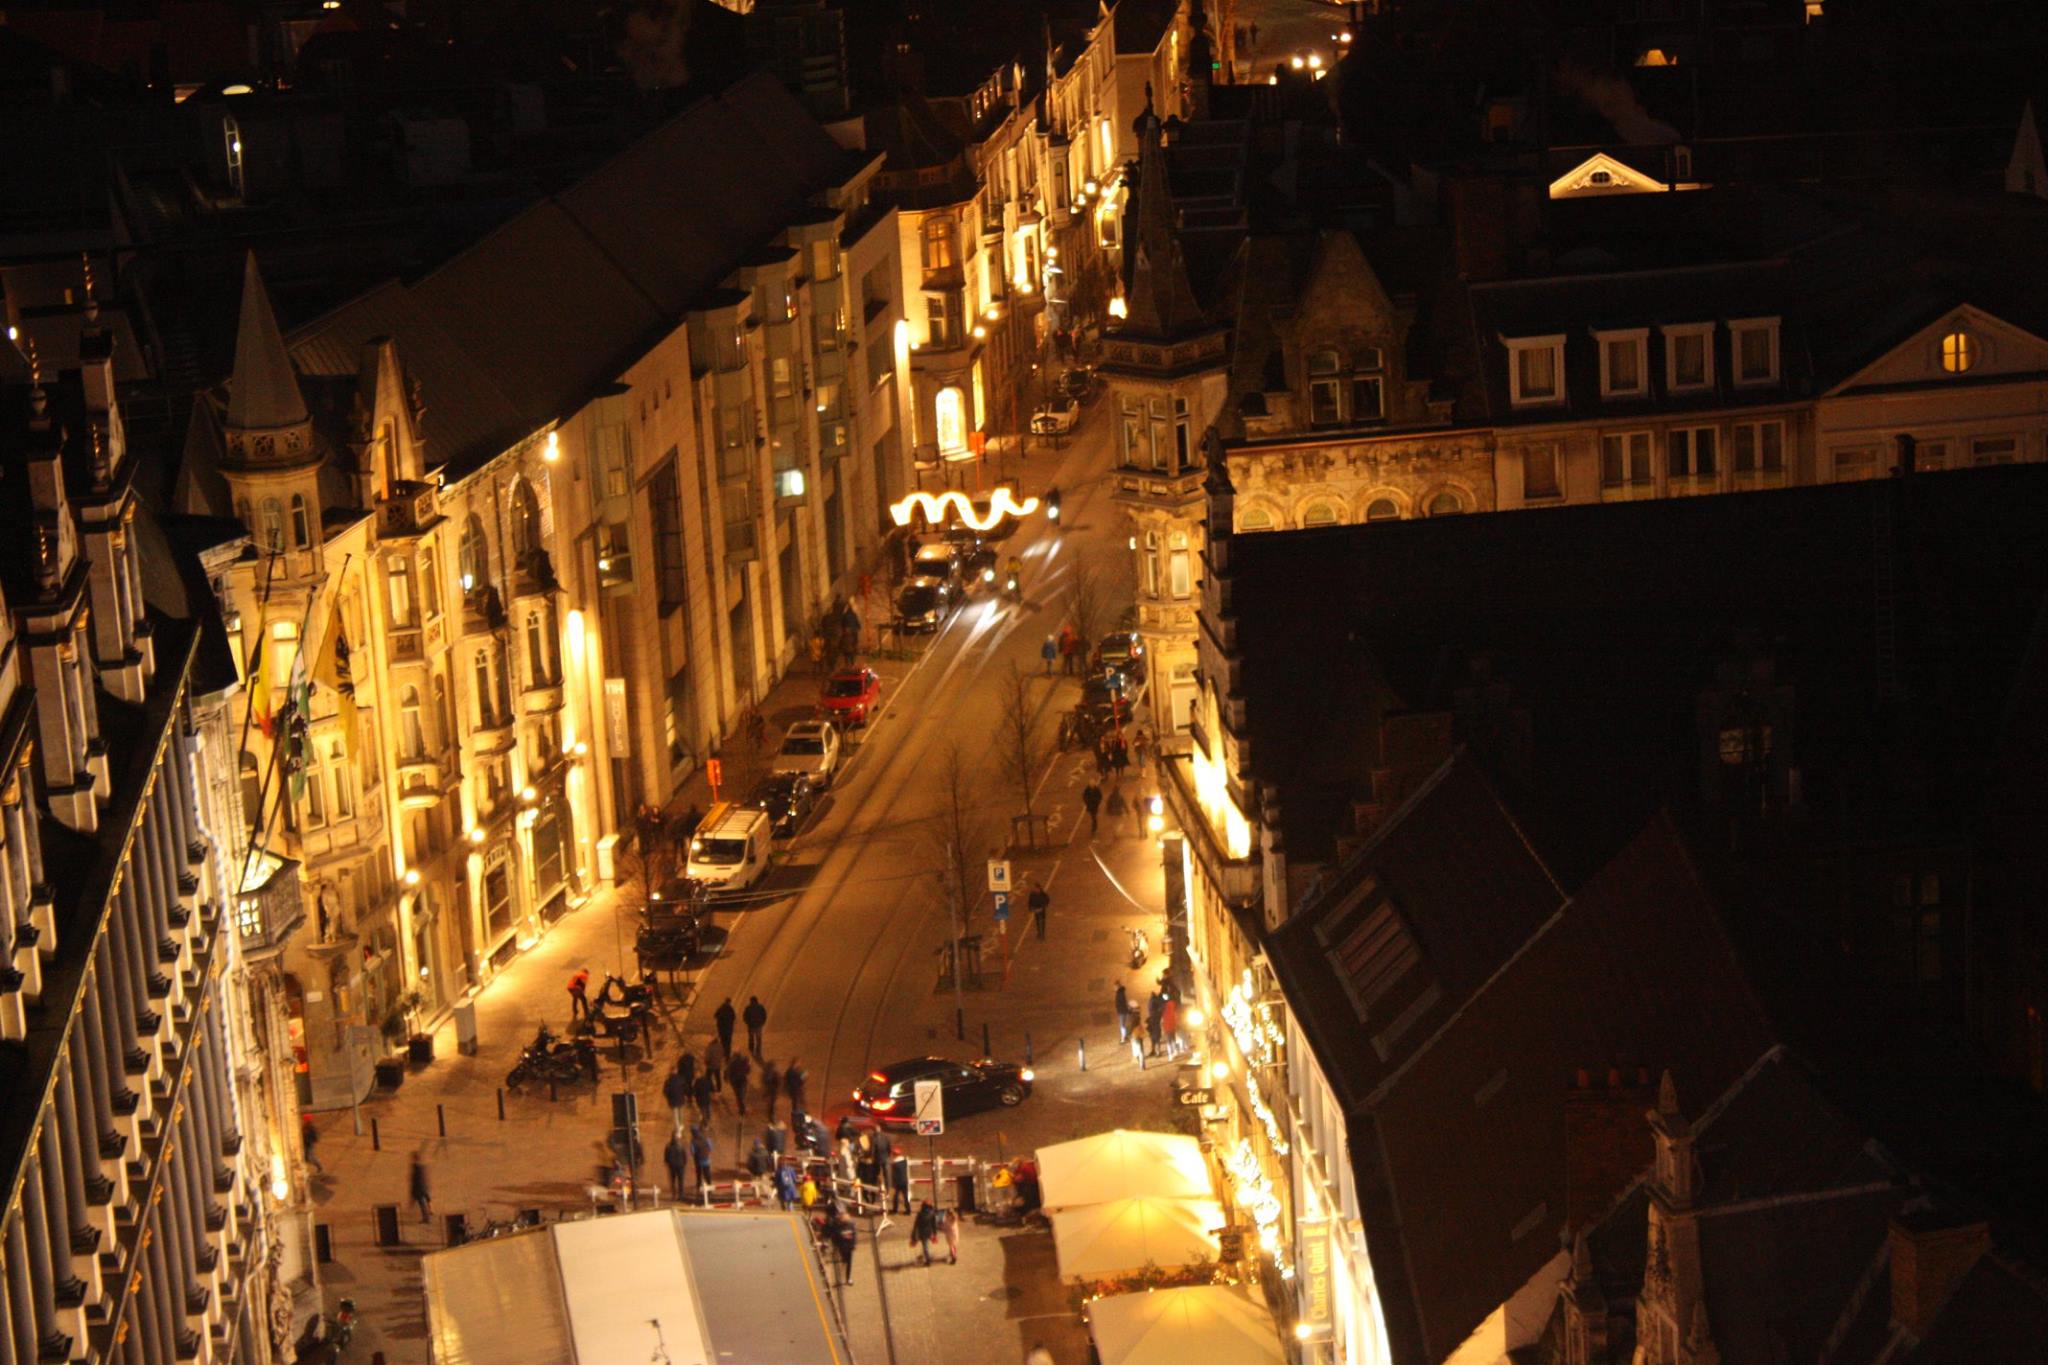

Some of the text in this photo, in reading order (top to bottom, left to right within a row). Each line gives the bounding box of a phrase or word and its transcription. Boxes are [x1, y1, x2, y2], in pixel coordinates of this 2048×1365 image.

[994, 894, 1006, 910] P
[1307, 1241, 1327, 1320] Charles Quint
